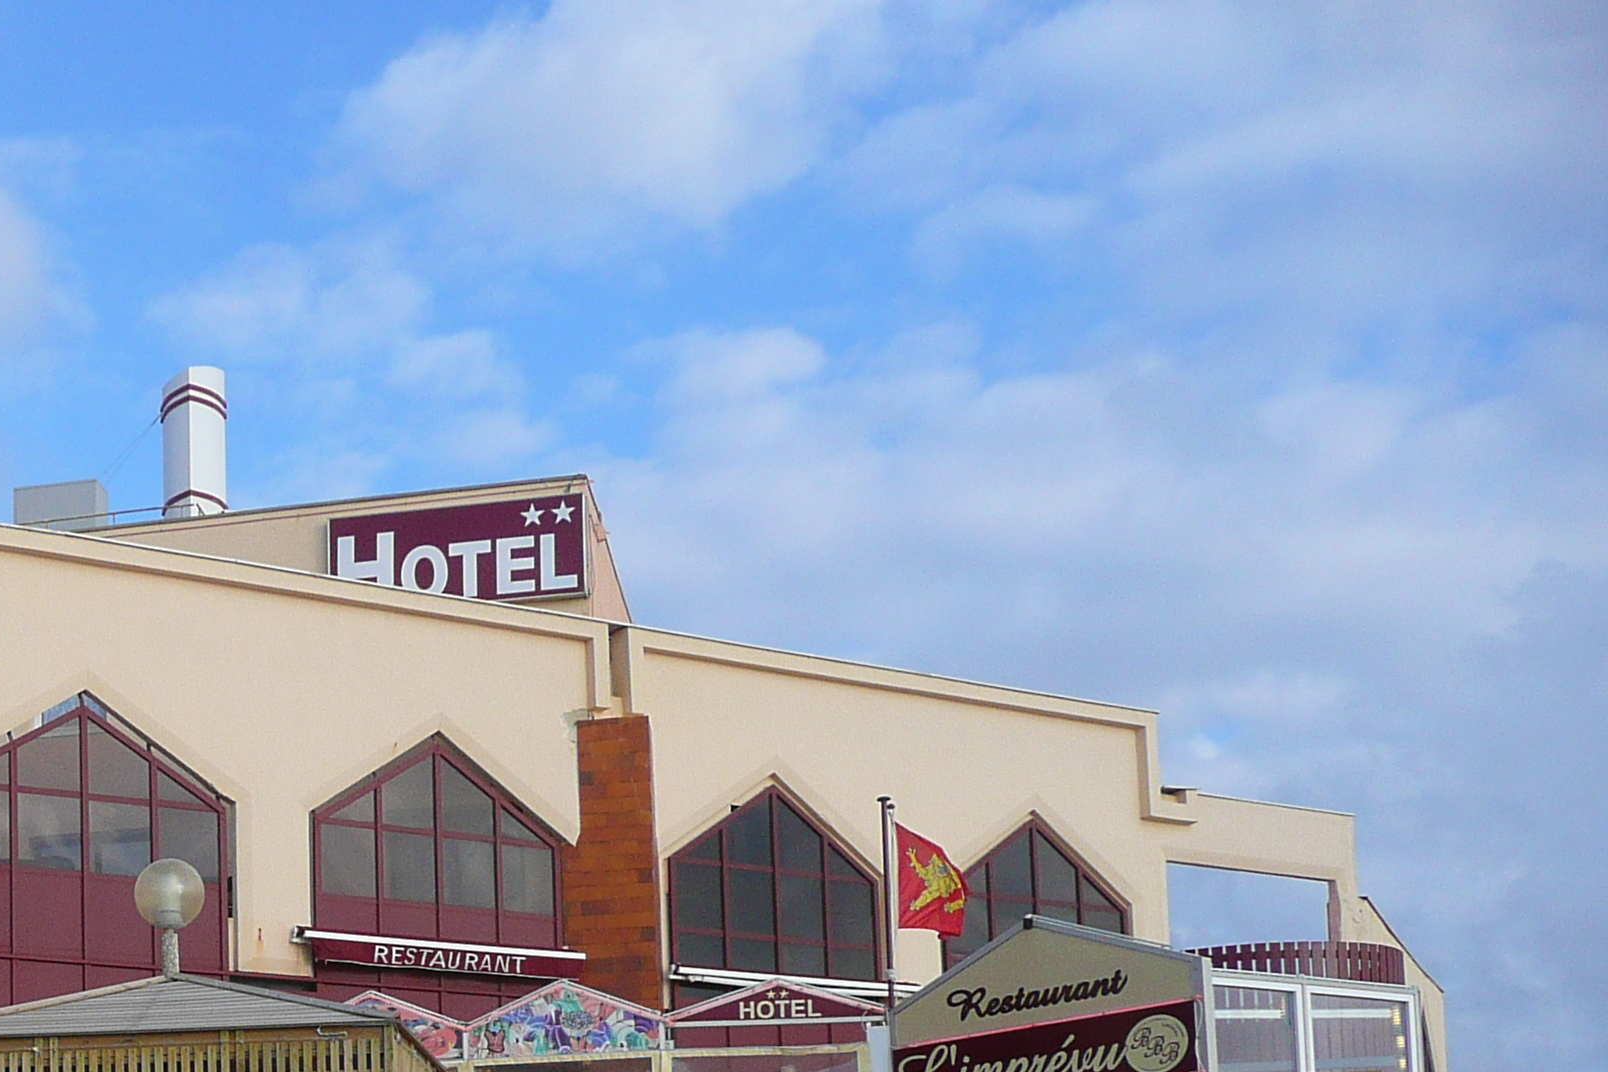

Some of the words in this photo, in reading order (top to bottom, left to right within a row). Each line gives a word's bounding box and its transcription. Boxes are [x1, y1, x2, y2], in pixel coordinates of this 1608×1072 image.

[337, 531, 578, 598] HOTEL
[373, 945, 527, 974] RESTAURANT
[738, 999, 822, 1020] HOTEL
[946, 969, 1129, 1022] Restaurant
